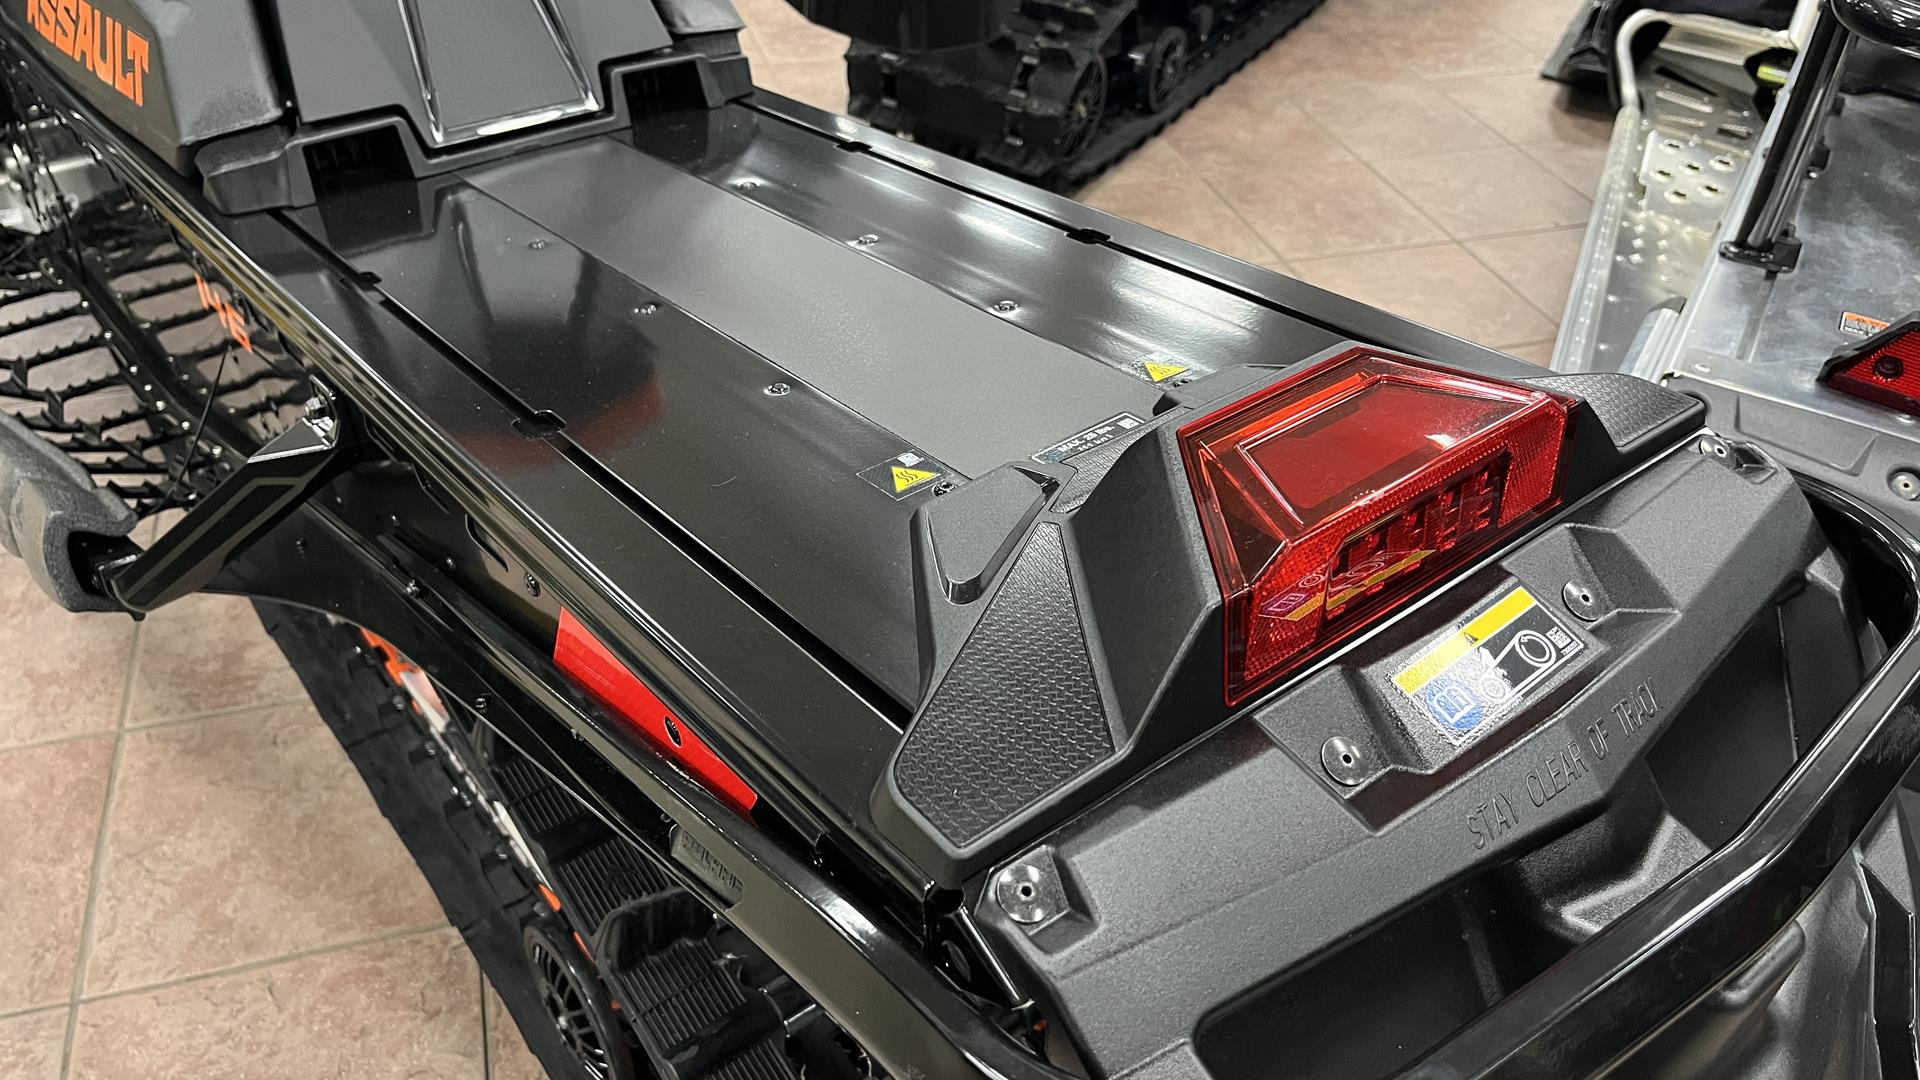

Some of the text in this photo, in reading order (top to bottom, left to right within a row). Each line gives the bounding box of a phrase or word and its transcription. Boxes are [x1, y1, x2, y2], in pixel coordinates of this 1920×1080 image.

[1467, 676, 1665, 850] STAY CLEAR OF TRACK
